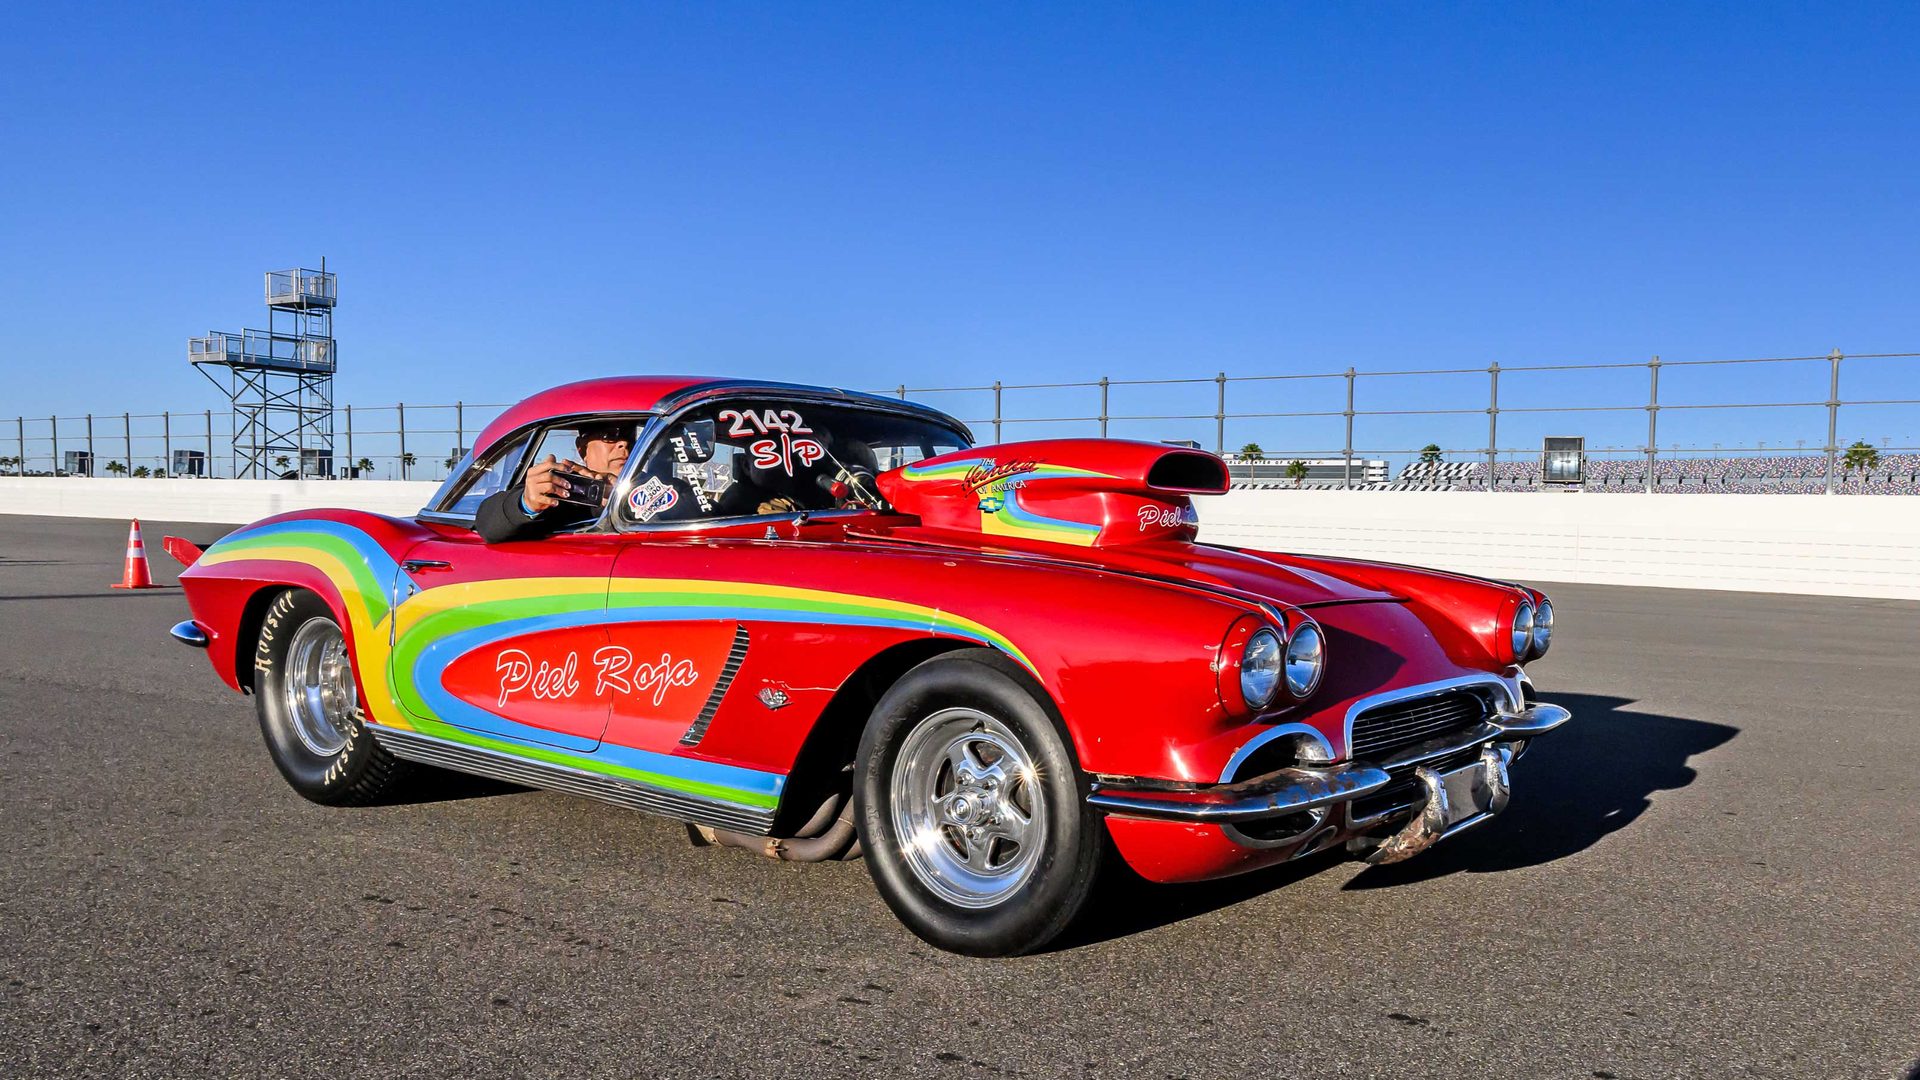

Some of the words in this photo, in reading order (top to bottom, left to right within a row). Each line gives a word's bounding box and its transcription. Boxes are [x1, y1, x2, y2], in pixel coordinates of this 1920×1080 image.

[719, 409, 813, 438] 2142
[688, 432, 707, 457] Legal
[670, 437, 689, 462] Pro
[682, 464, 712, 512] Street
[982, 458, 996, 466] THE
[977, 484, 988, 494] OF
[991, 480, 1026, 493] AMERICA
[1137, 504, 1182, 531] Piel
[254, 590, 295, 677] Hoosier
[496, 649, 579, 707] Piel
[593, 645, 698, 706] Roja
